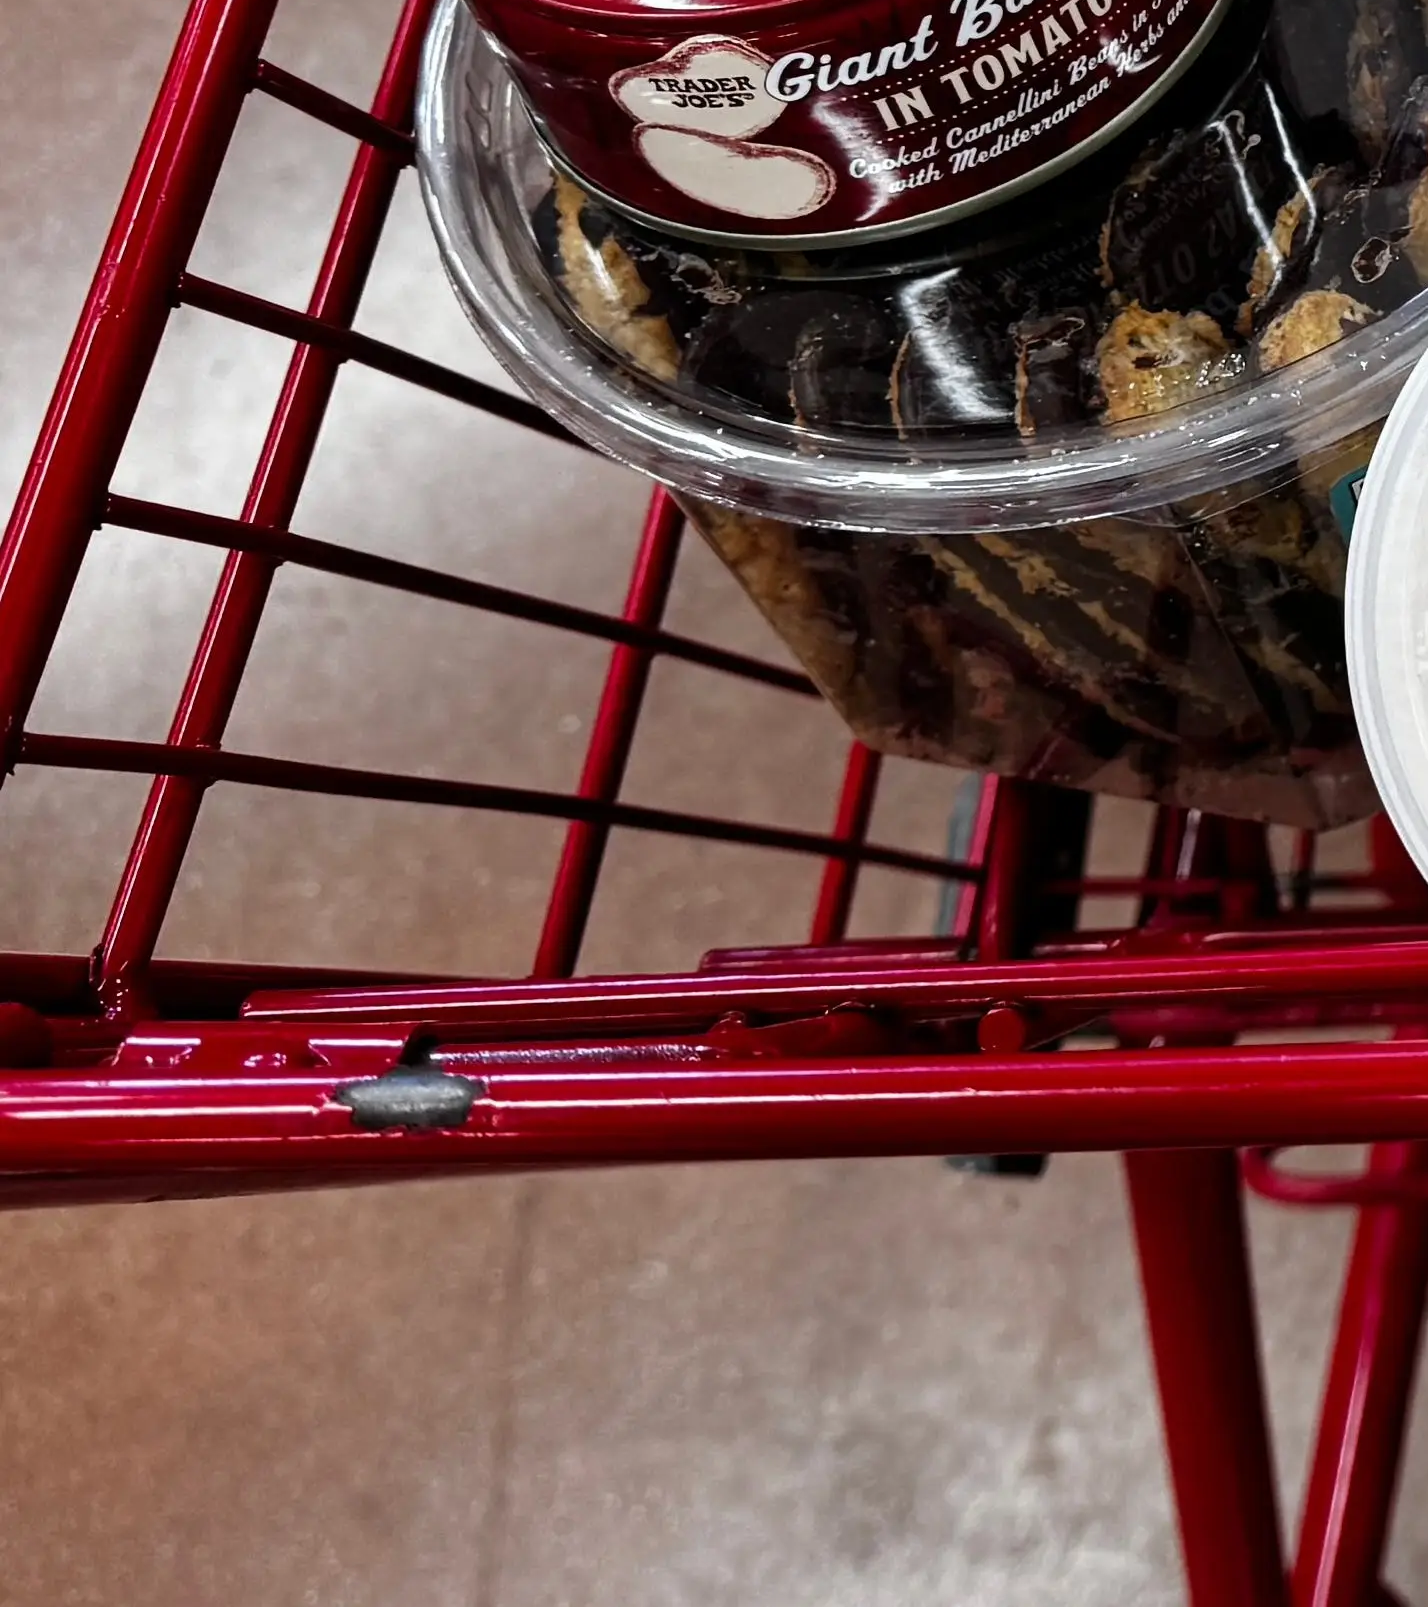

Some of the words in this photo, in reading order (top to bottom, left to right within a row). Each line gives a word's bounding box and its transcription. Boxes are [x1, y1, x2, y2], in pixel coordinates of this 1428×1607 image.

[648, 76, 757, 93] TRADER
[765, 14, 939, 102] Giant
[850, 137, 940, 179] Cooked
[946, 79, 1063, 149] Cannellini
[1067, 28, 1129, 86] Beans
[1132, 9, 1149, 33] in
[872, 85, 935, 132] IN
[888, 163, 944, 194] with
[948, 76, 1112, 174] Mediterranean
[1116, 23, 1164, 78] Herbs
